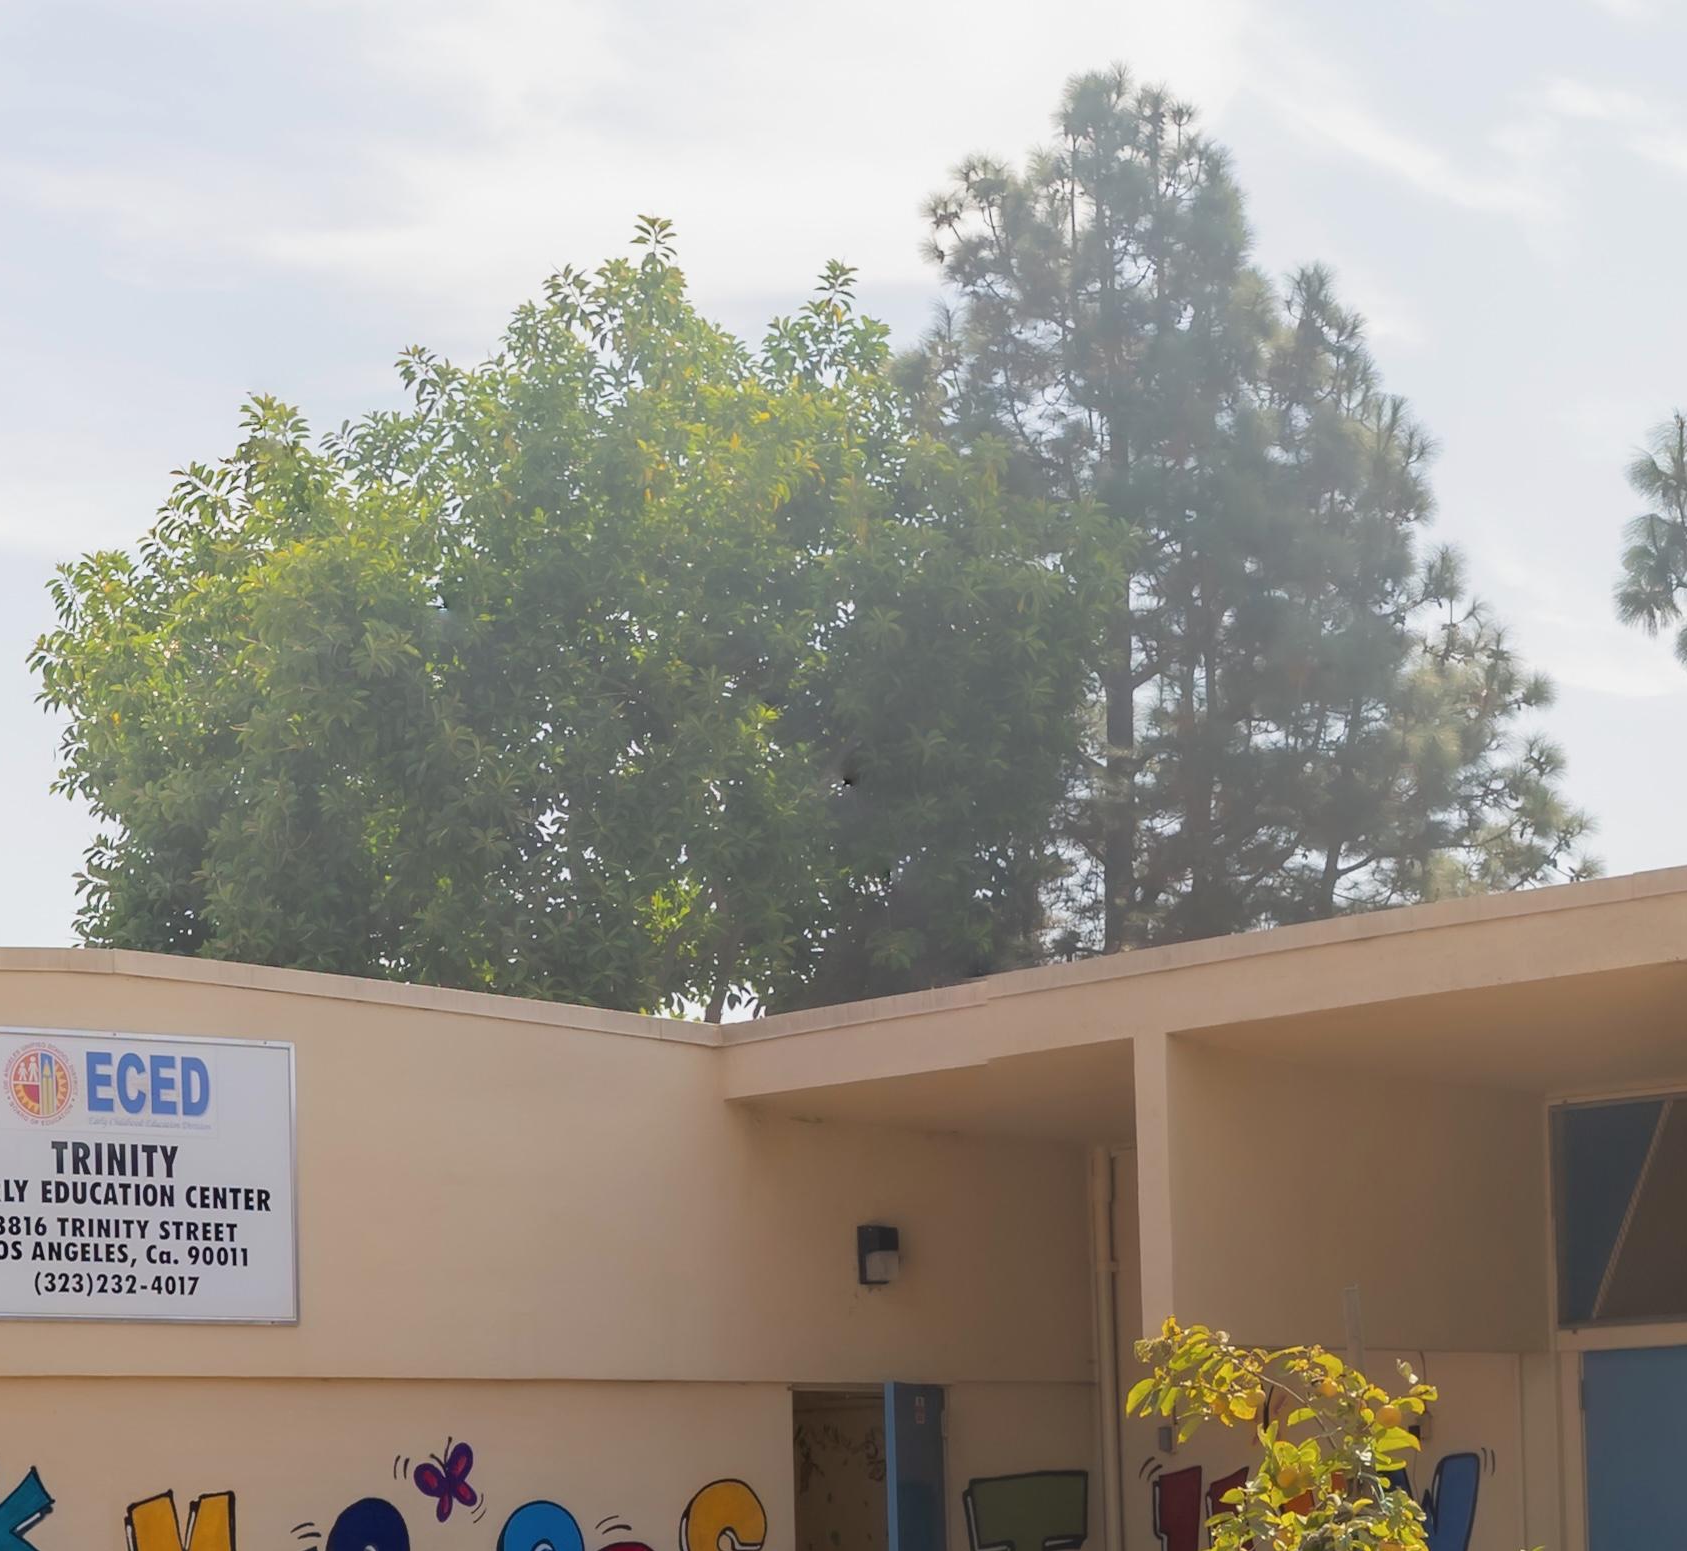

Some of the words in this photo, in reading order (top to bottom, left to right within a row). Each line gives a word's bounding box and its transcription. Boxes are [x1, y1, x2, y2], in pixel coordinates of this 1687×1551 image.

[85, 1051, 210, 1117] ECED
[51, 1140, 179, 1178] TRINITY
[41, 1180, 175, 1208] EDUCATION
[185, 1185, 271, 1212] CENTER
[57, 1217, 150, 1240] TRINITY
[159, 1220, 238, 1242] STREET
[31, 1242, 138, 1268] ANGELES,
[146, 1245, 179, 1265] Ca.
[187, 1246, 248, 1267] 90011
[34, 1271, 200, 1297] (323)232-4017
